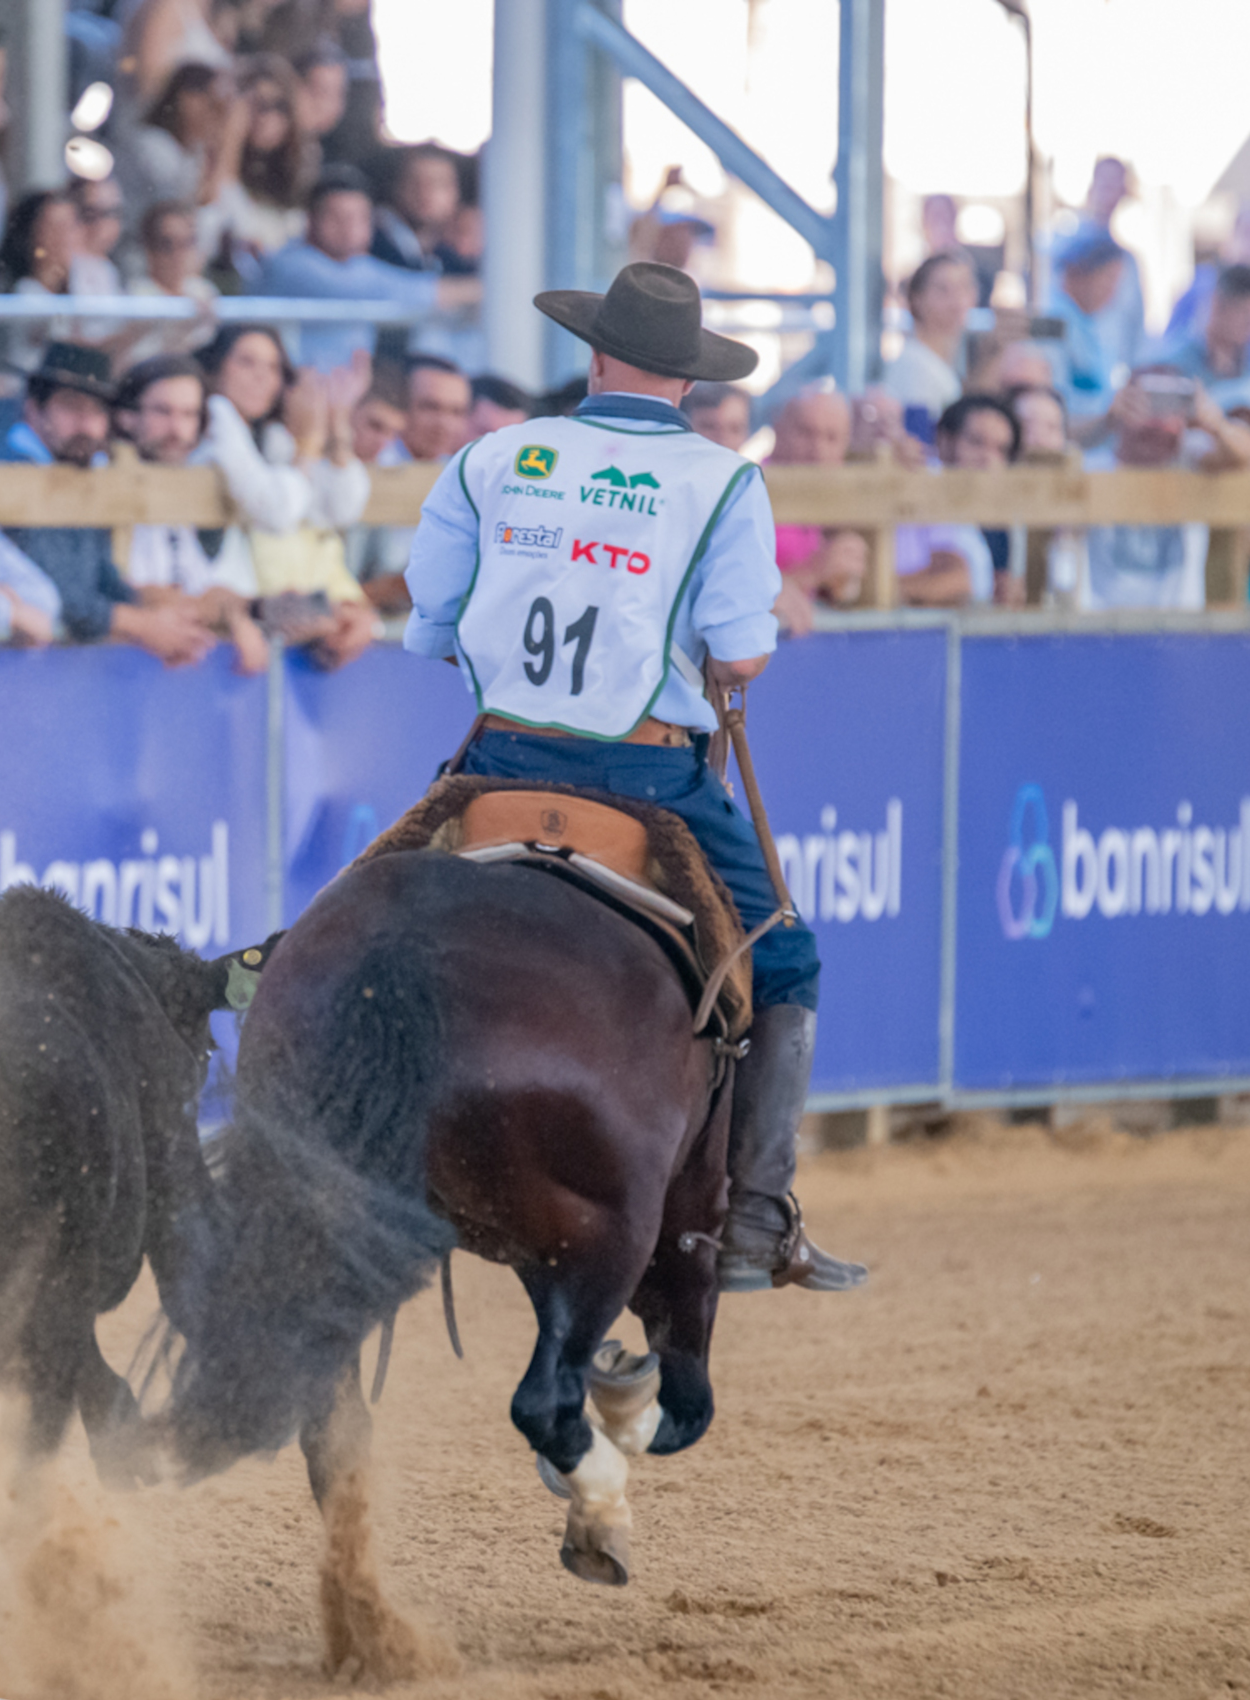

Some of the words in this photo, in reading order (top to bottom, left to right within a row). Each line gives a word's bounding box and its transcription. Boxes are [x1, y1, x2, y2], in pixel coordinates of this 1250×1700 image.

[525, 484, 566, 501] DEERE
[579, 485, 658, 516] VETNIL
[571, 538, 652, 576] KTO
[523, 596, 599, 696] 91
[775, 796, 903, 922] nrisul
[1061, 797, 1250, 920] banrisul
